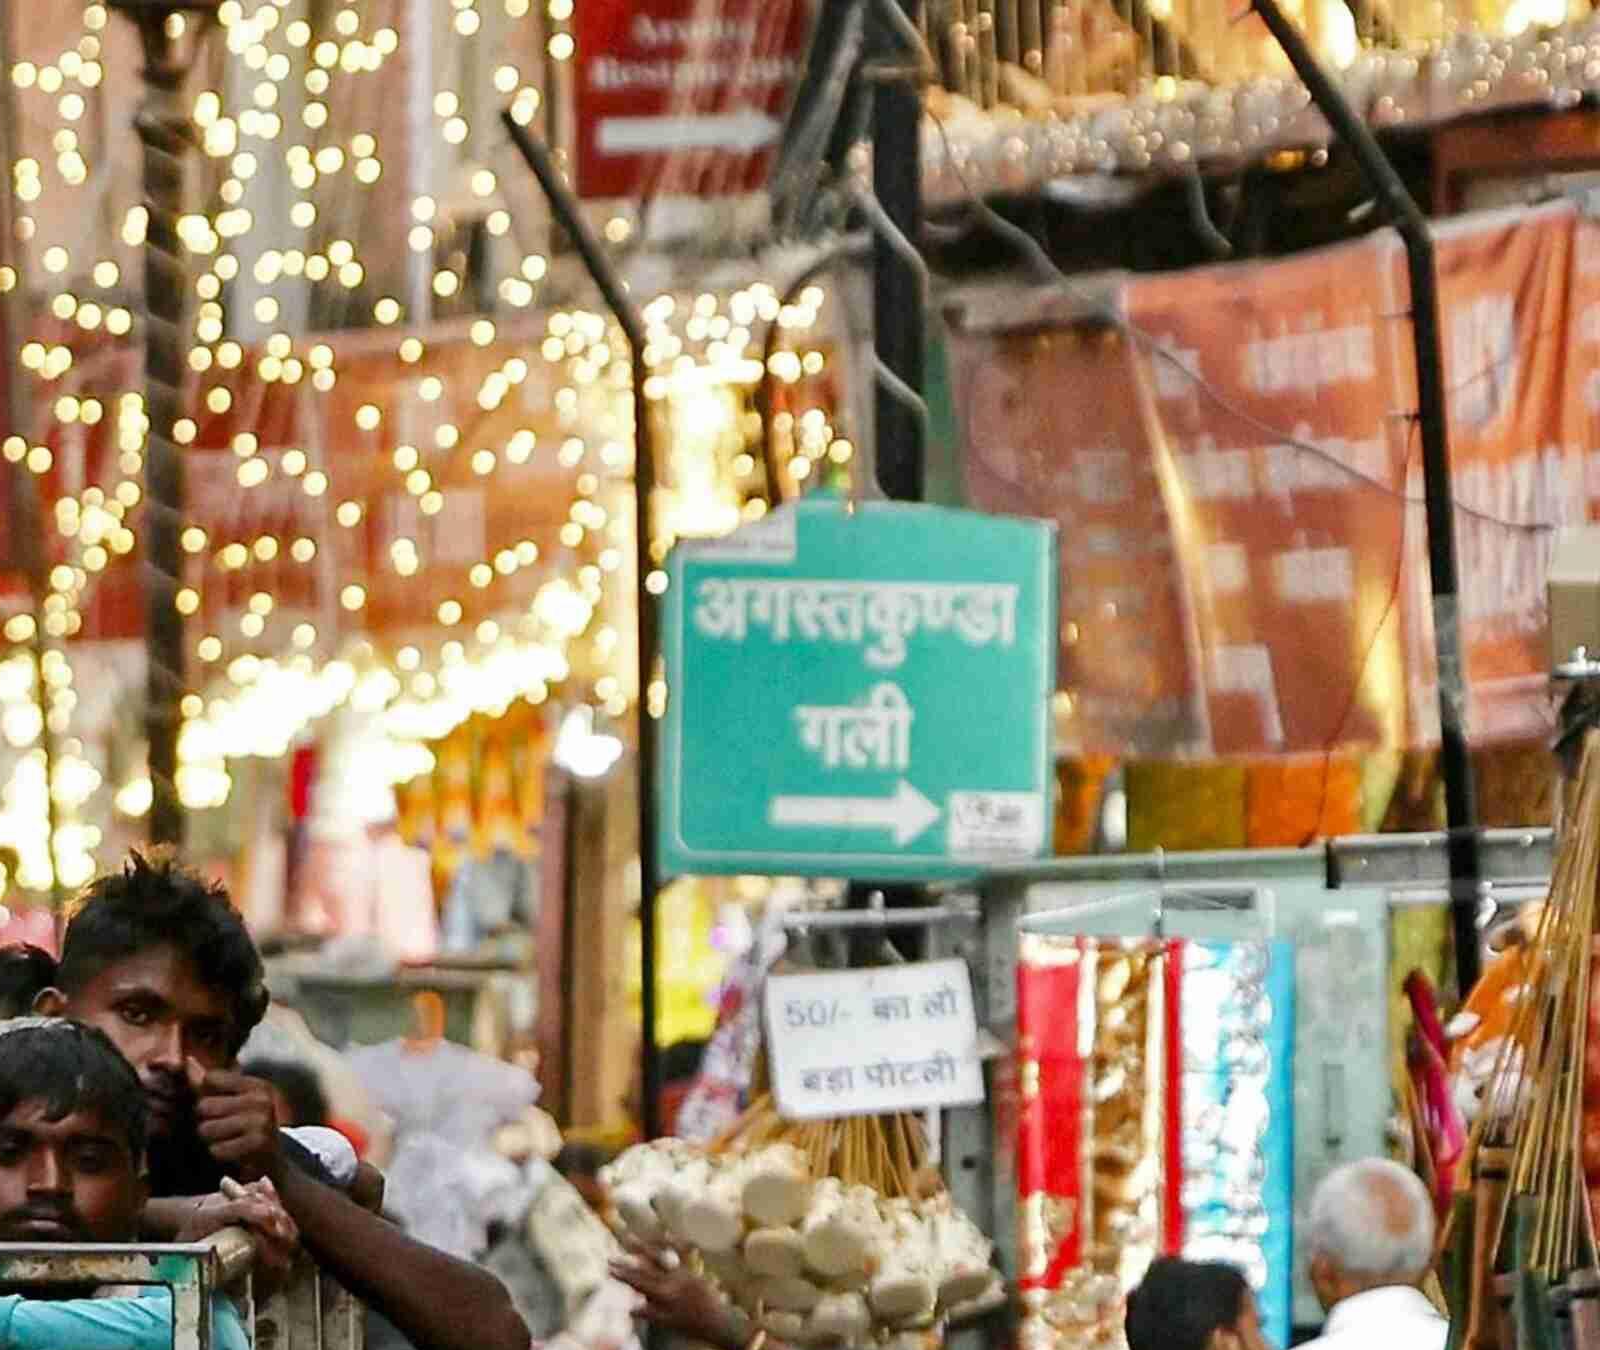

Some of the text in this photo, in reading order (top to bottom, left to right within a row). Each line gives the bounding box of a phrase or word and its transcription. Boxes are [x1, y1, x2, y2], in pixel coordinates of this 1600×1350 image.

[694, 578, 1019, 670] अगस्तकुण्डा
[793, 682, 914, 770] गली
[784, 1000, 852, 1026] 50/-
